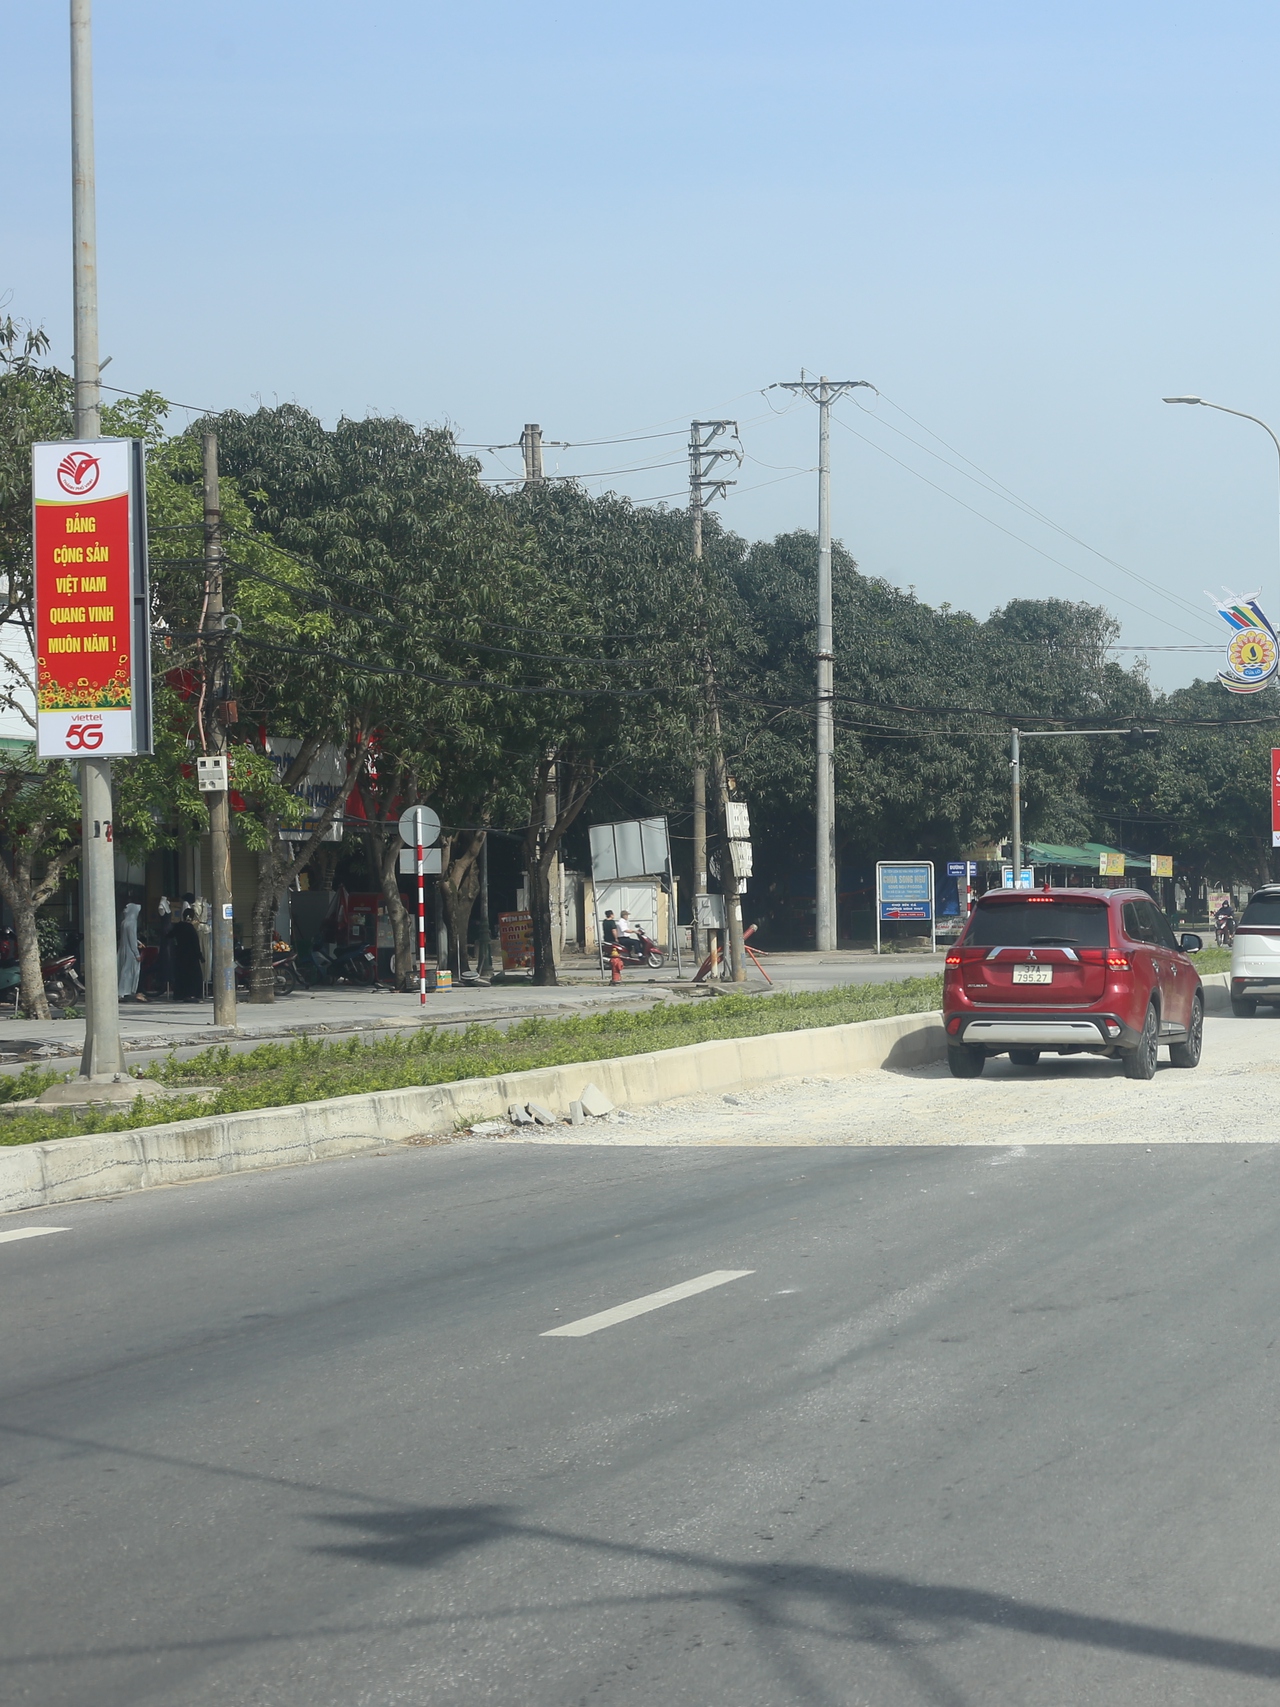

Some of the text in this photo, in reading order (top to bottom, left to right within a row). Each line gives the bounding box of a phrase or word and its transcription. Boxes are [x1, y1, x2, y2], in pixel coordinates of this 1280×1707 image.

[66, 512, 96, 534] ĐẢNG
[54, 542, 108, 566] CỘNG SẢN
[56, 574, 106, 596] VIỆT NAM
[50, 606, 114, 626] QUANG VINH
[48, 634, 80, 654] MUÔN
[84, 634, 109, 652] NĂM
[72, 714, 103, 722] viettel
[66, 724, 104, 750] 5G
[1018, 974, 1047, 982] 795.27
